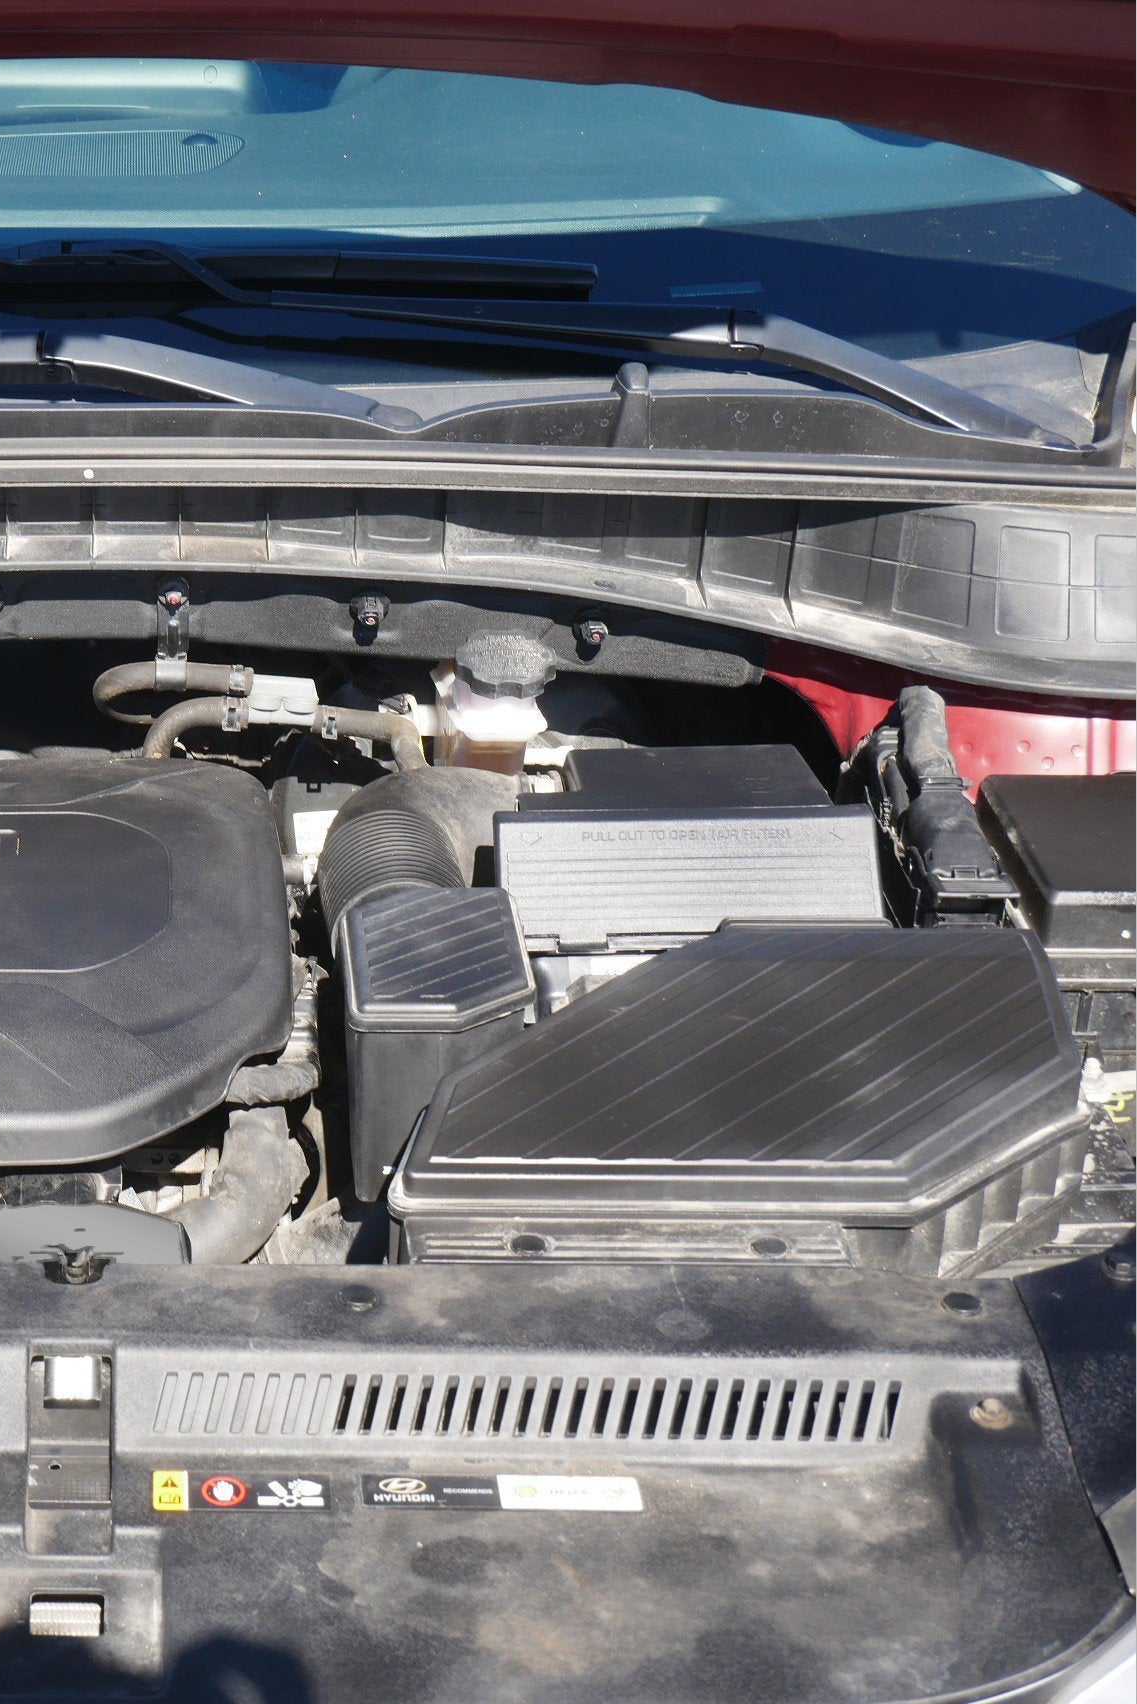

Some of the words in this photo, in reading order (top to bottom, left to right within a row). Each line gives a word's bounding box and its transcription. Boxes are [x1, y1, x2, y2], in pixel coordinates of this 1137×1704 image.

[581, 831, 615, 842] PULL
[618, 830, 644, 841] OUT
[648, 830, 665, 841] TO
[668, 829, 706, 841] OPEN
[442, 1486, 494, 1496] RECOMMENDS
[373, 1492, 436, 1504] HYUNDAI
